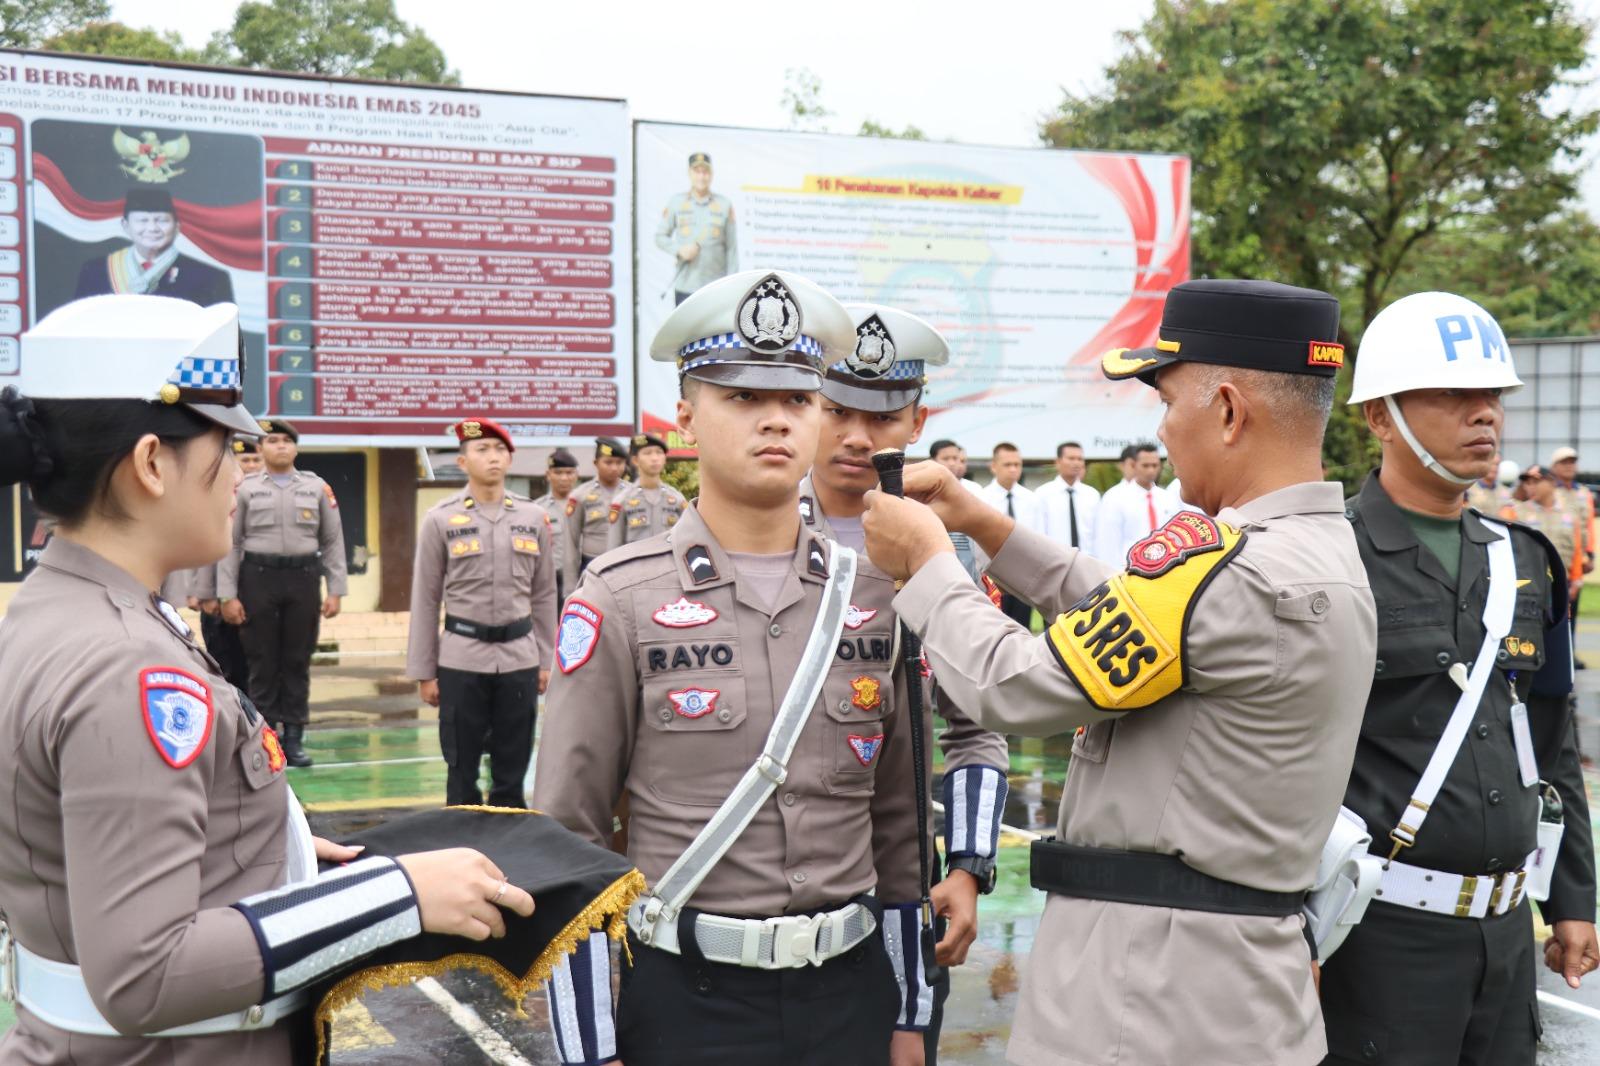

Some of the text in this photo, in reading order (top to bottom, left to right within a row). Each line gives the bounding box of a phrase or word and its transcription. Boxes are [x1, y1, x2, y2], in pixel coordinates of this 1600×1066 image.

[25, 67, 140, 92] BERSAMA
[147, 79, 236, 101] MENUJU
[243, 88, 359, 110] INDONESIA
[366, 97, 422, 115] EMAS
[429, 101, 482, 119] 2045
[47, 89, 87, 101] 2045
[91, 92, 176, 107] dibutuhkan
[117, 107, 132, 117] 17
[140, 108, 207, 123] Program
[213, 115, 279, 129] Prioritas
[306, 142, 383, 158] ARAHAN
[387, 147, 474, 164] PRESIDEN
[478, 152, 497, 165] RI
[500, 153, 545, 168] SAAT
[290, 163, 299, 176] 1
[288, 189, 302, 202] 2
[402, 193, 430, 206] yang
[505, 199, 527, 208] dan
[289, 219, 302, 233] 3
[384, 219, 413, 230] kerja
[287, 255, 301, 269] 4
[318, 249, 362, 261] Pelajari
[407, 254, 430, 263] dan
[541, 259, 569, 270] yang
[318, 283, 371, 295] Birokrasi
[379, 285, 401, 296] kita
[288, 293, 302, 307] 5
[374, 295, 396, 305] kita
[398, 296, 429, 307] perlu
[360, 304, 390, 316] yang
[394, 306, 416, 315] ada
[420, 307, 446, 318] agar
[288, 328, 302, 342] 6
[318, 327, 369, 339] Pastikan
[372, 329, 410, 340] semua
[412, 330, 460, 343] program
[462, 331, 490, 342] kerja
[1435, 315, 1506, 363] PM
[318, 337, 349, 349] yang
[453, 341, 475, 350] dan
[290, 355, 302, 369] 7
[318, 353, 388, 365] Prioritaskan
[318, 362, 356, 375] energi
[357, 364, 380, 374] dan
[499, 366, 535, 377] makan
[289, 388, 304, 402] 8
[322, 408, 400, 419] dan anggaran
[648, 642, 734, 672] RAYO
[836, 636, 892, 664] OLRI
